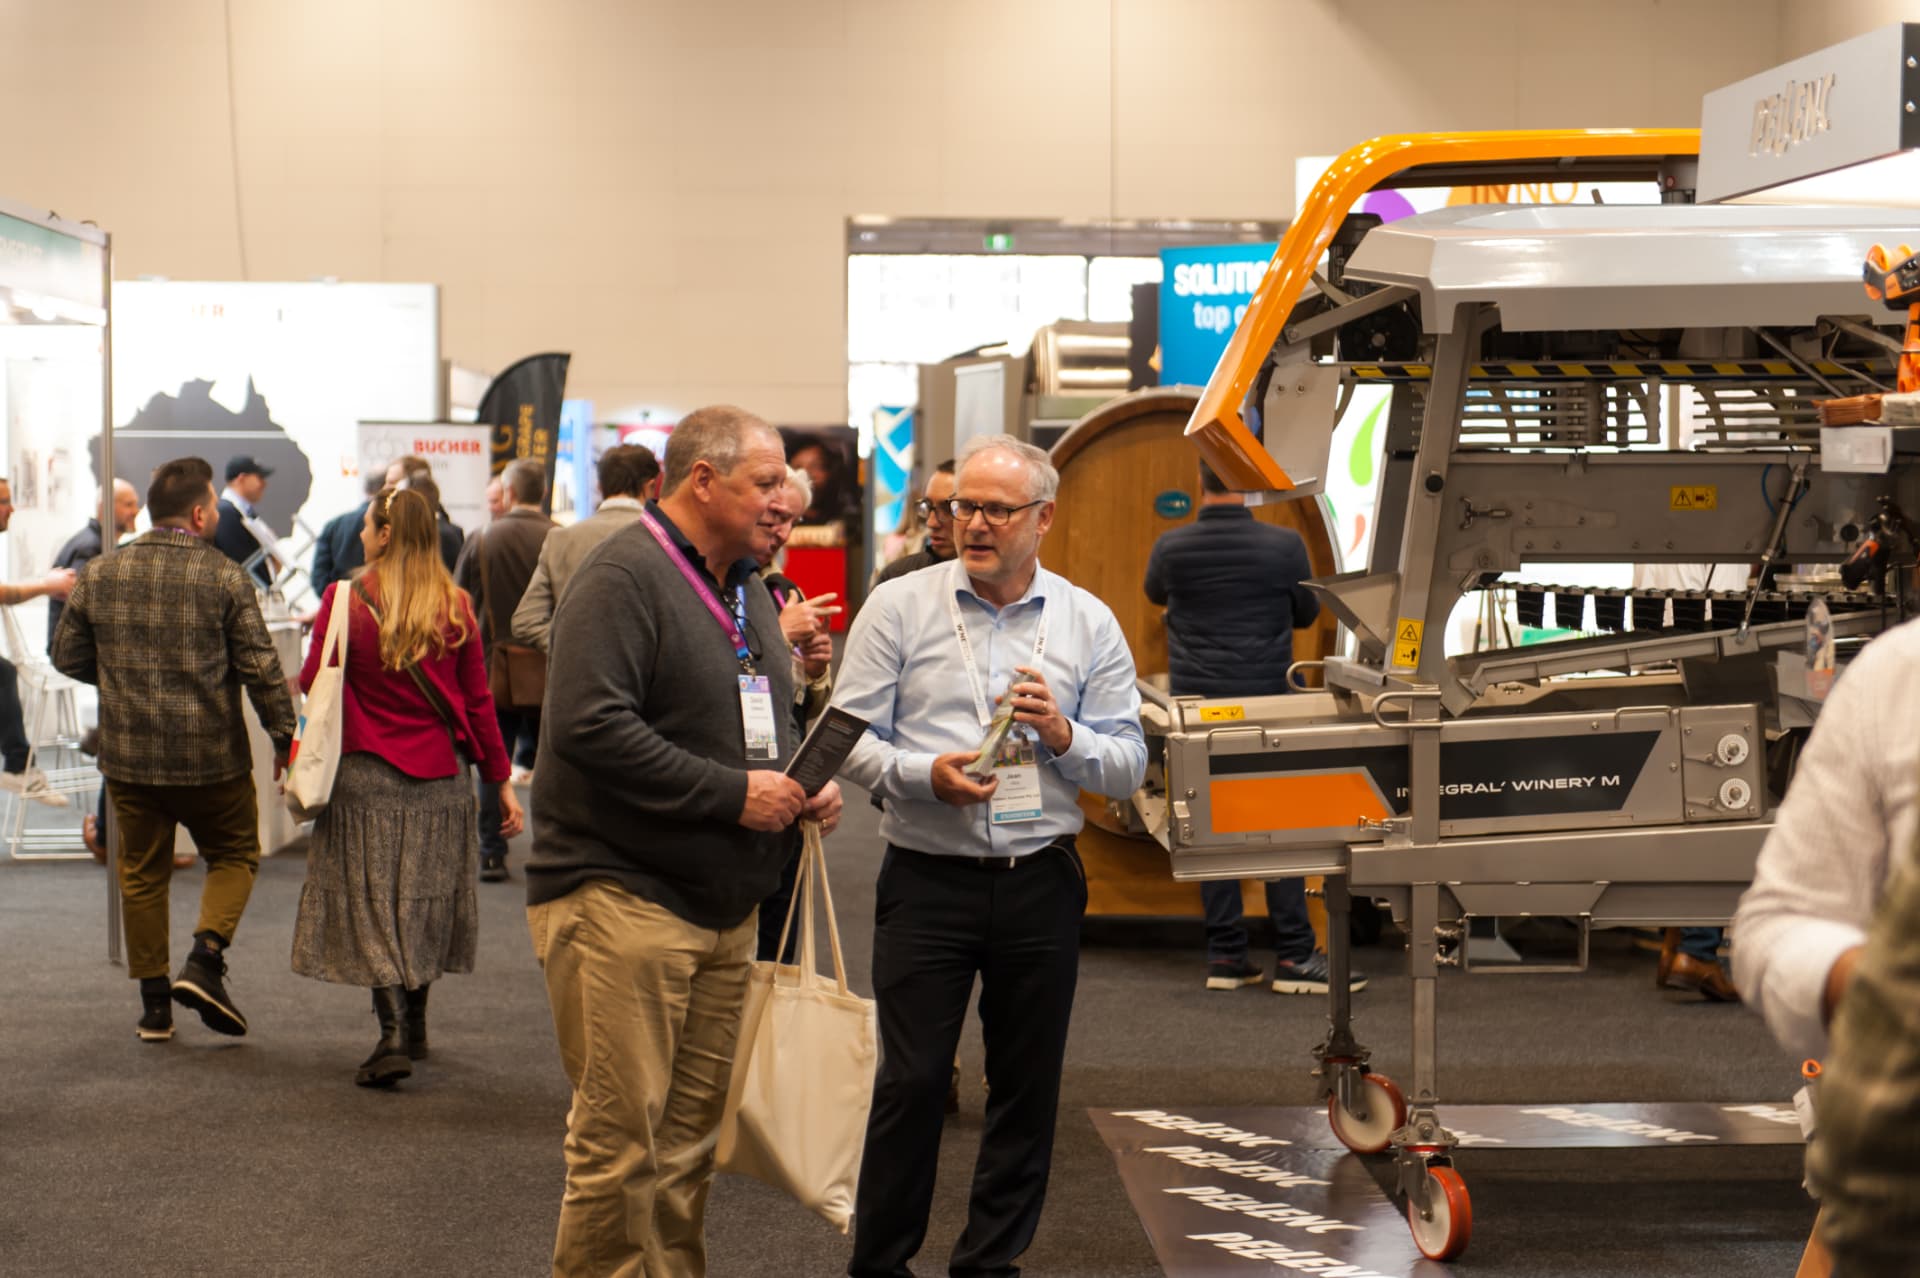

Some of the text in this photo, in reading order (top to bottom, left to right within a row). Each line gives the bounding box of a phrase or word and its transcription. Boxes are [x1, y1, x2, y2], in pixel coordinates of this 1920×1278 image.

[1193, 301, 1231, 334] top
[413, 440, 481, 454] BUCHER
[1396, 775, 1620, 798] IGRAL' WINERY M
[1161, 1185, 1368, 1234] PELLENC
